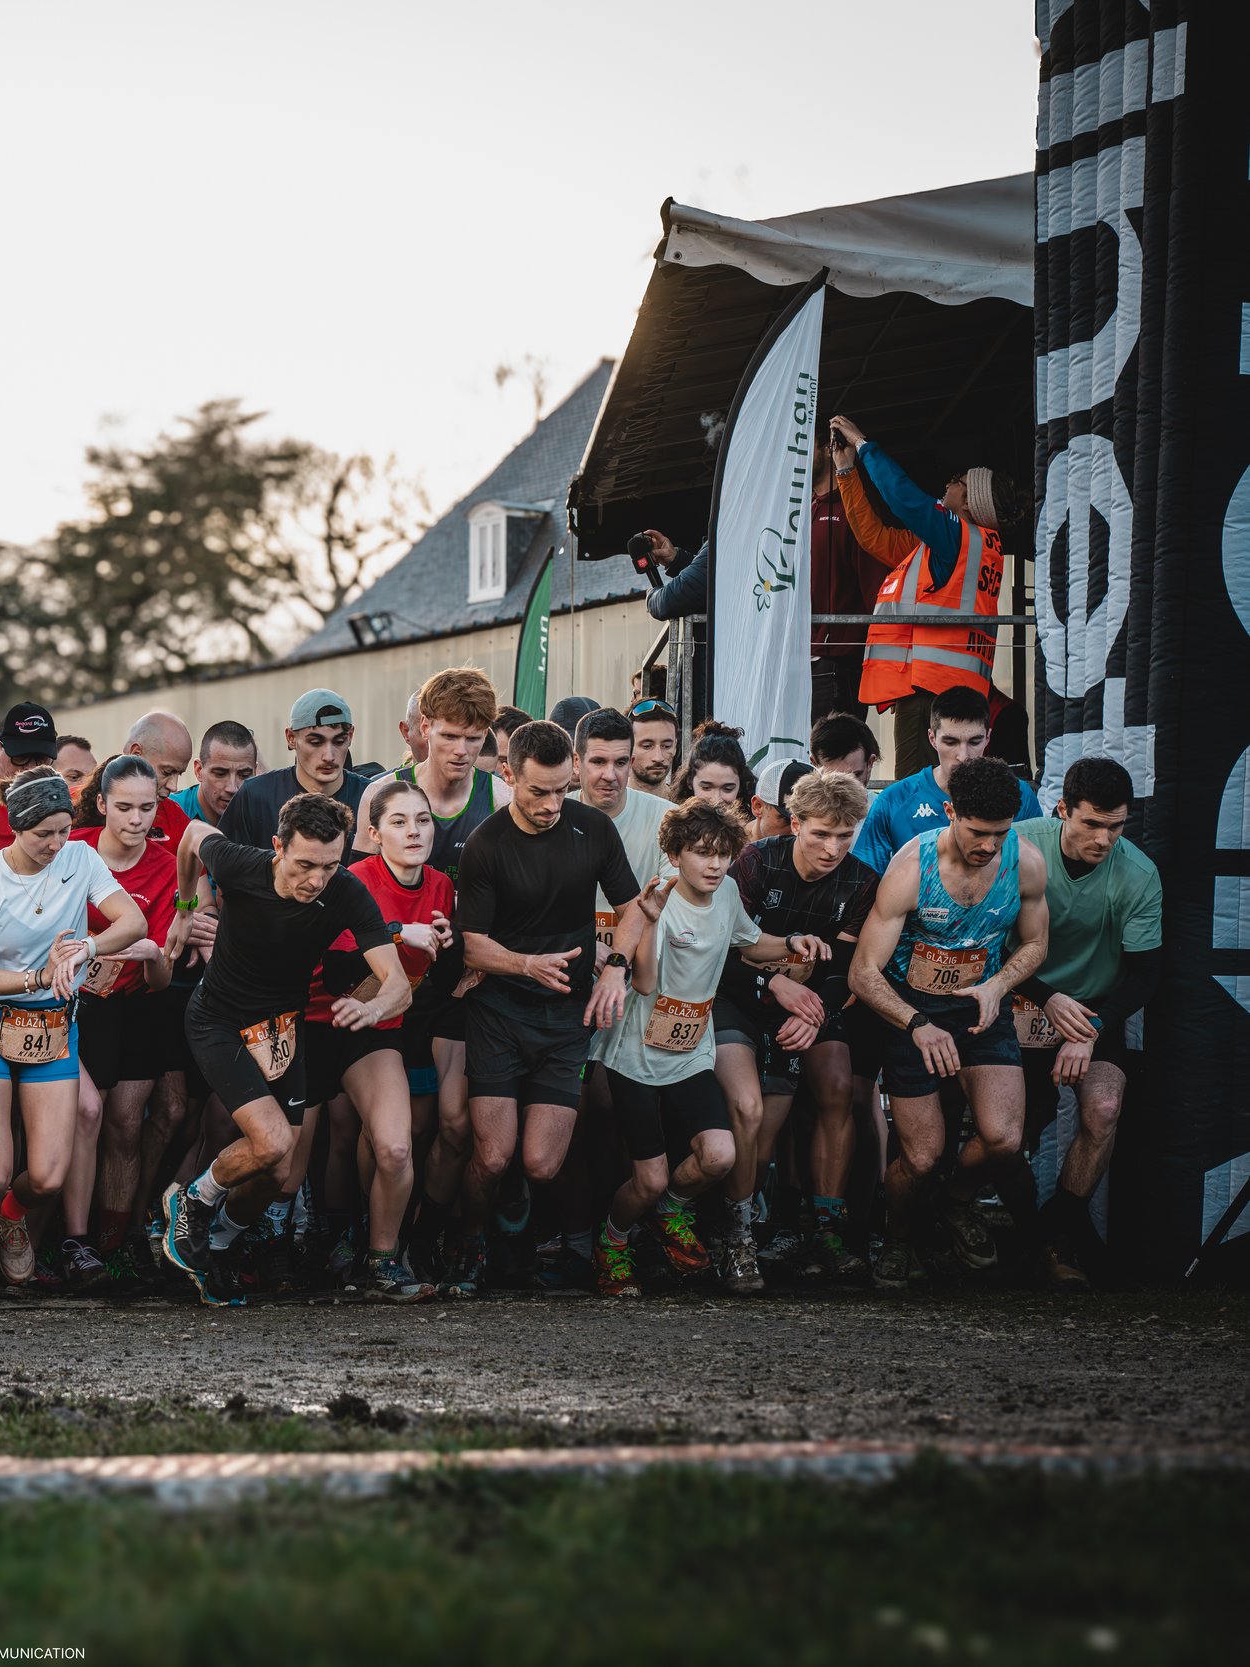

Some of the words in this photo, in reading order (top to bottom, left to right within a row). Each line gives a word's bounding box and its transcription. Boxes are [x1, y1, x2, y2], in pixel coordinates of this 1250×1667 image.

[926, 951, 958, 965] GLAZIG
[969, 953, 980, 961] 5K
[933, 967, 961, 985] 706
[668, 1005, 699, 1018] GLAZIG
[670, 1022, 700, 1040] 837
[23, 1034, 51, 1051] 841
[17, 1050, 54, 1058] KINETIK
